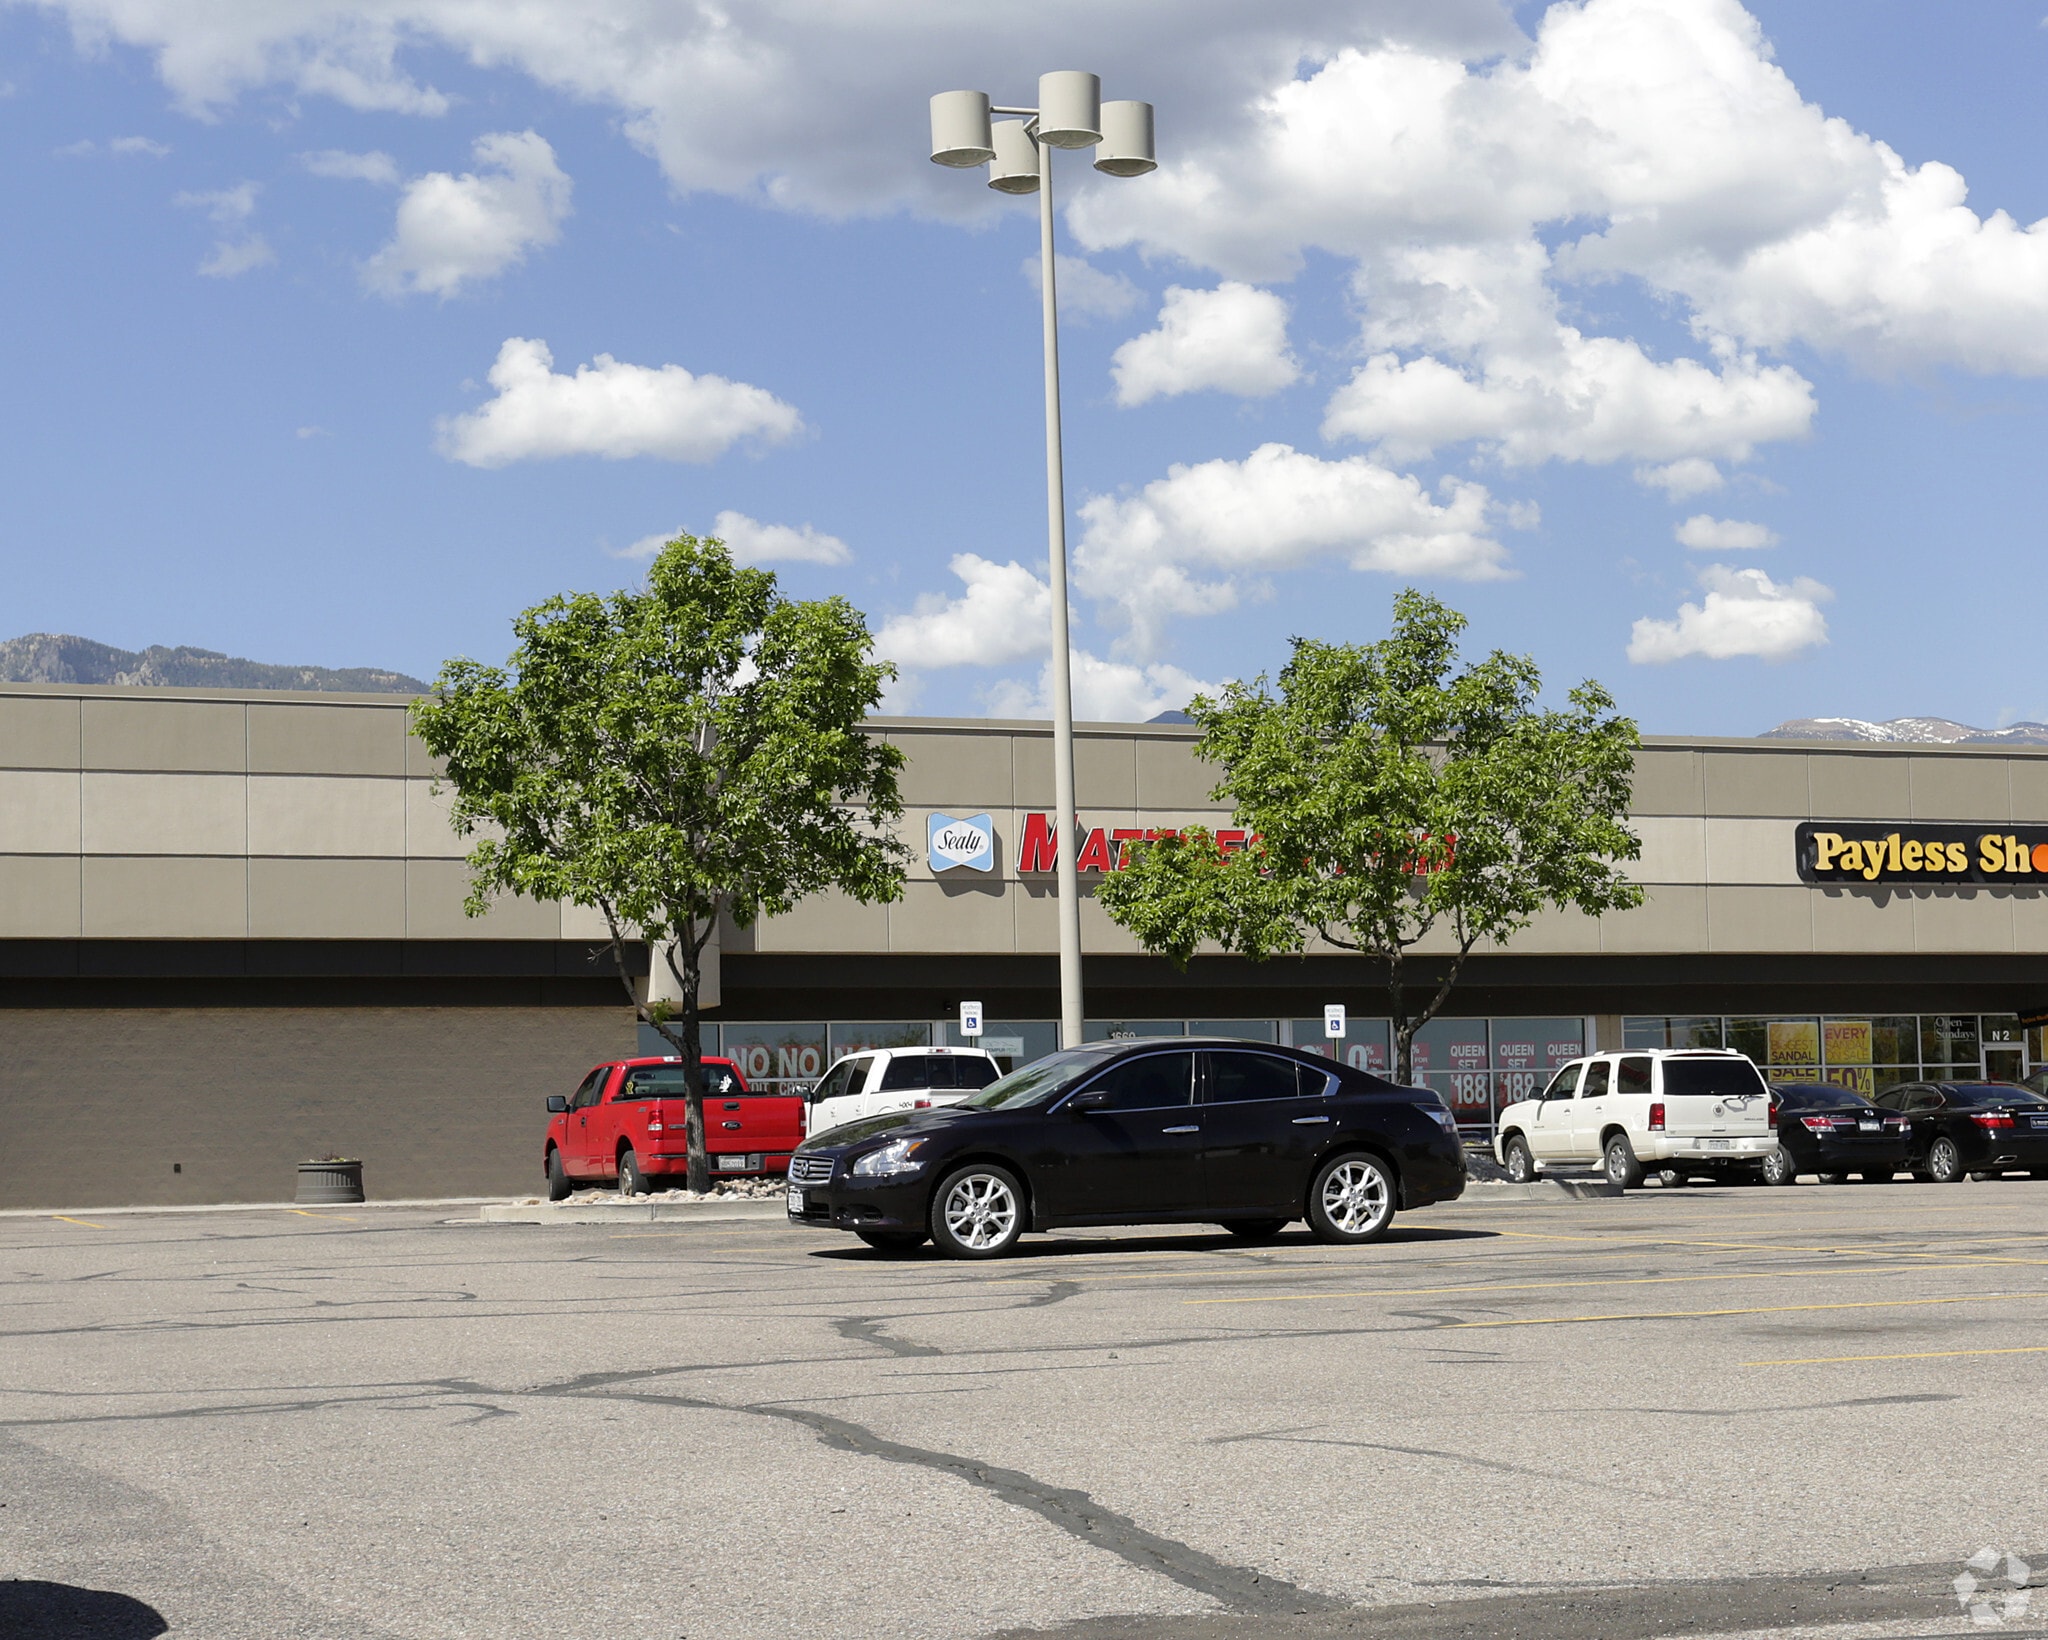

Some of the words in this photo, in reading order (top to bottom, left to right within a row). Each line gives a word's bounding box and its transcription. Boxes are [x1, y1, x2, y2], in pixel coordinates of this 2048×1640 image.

[937, 830, 982, 854] Sealy
[1813, 832, 1968, 880] Payless
[1935, 1017, 1962, 1031] Open
[1824, 1028, 1867, 1040] EVERY
[1935, 1028, 1975, 1040] Sundays
[1992, 1031, 2000, 1041] N
[2003, 1031, 2010, 1041] 2
[1450, 1045, 1486, 1057] QUEEN
[1500, 1044, 1535, 1056] QUEEN
[1547, 1043, 1582, 1056] QUEEN
[1771, 1040, 1814, 1050] BIGGEST
[1771, 1051, 1815, 1061] SANDAL
[728, 1047, 770, 1078] NO
[778, 1047, 820, 1078] NO
[1458, 1059, 1478, 1070] SET
[1507, 1058, 1527, 1070] SET
[1772, 1063, 1815, 1077] SALE
[1450, 1073, 1488, 1105] $188
